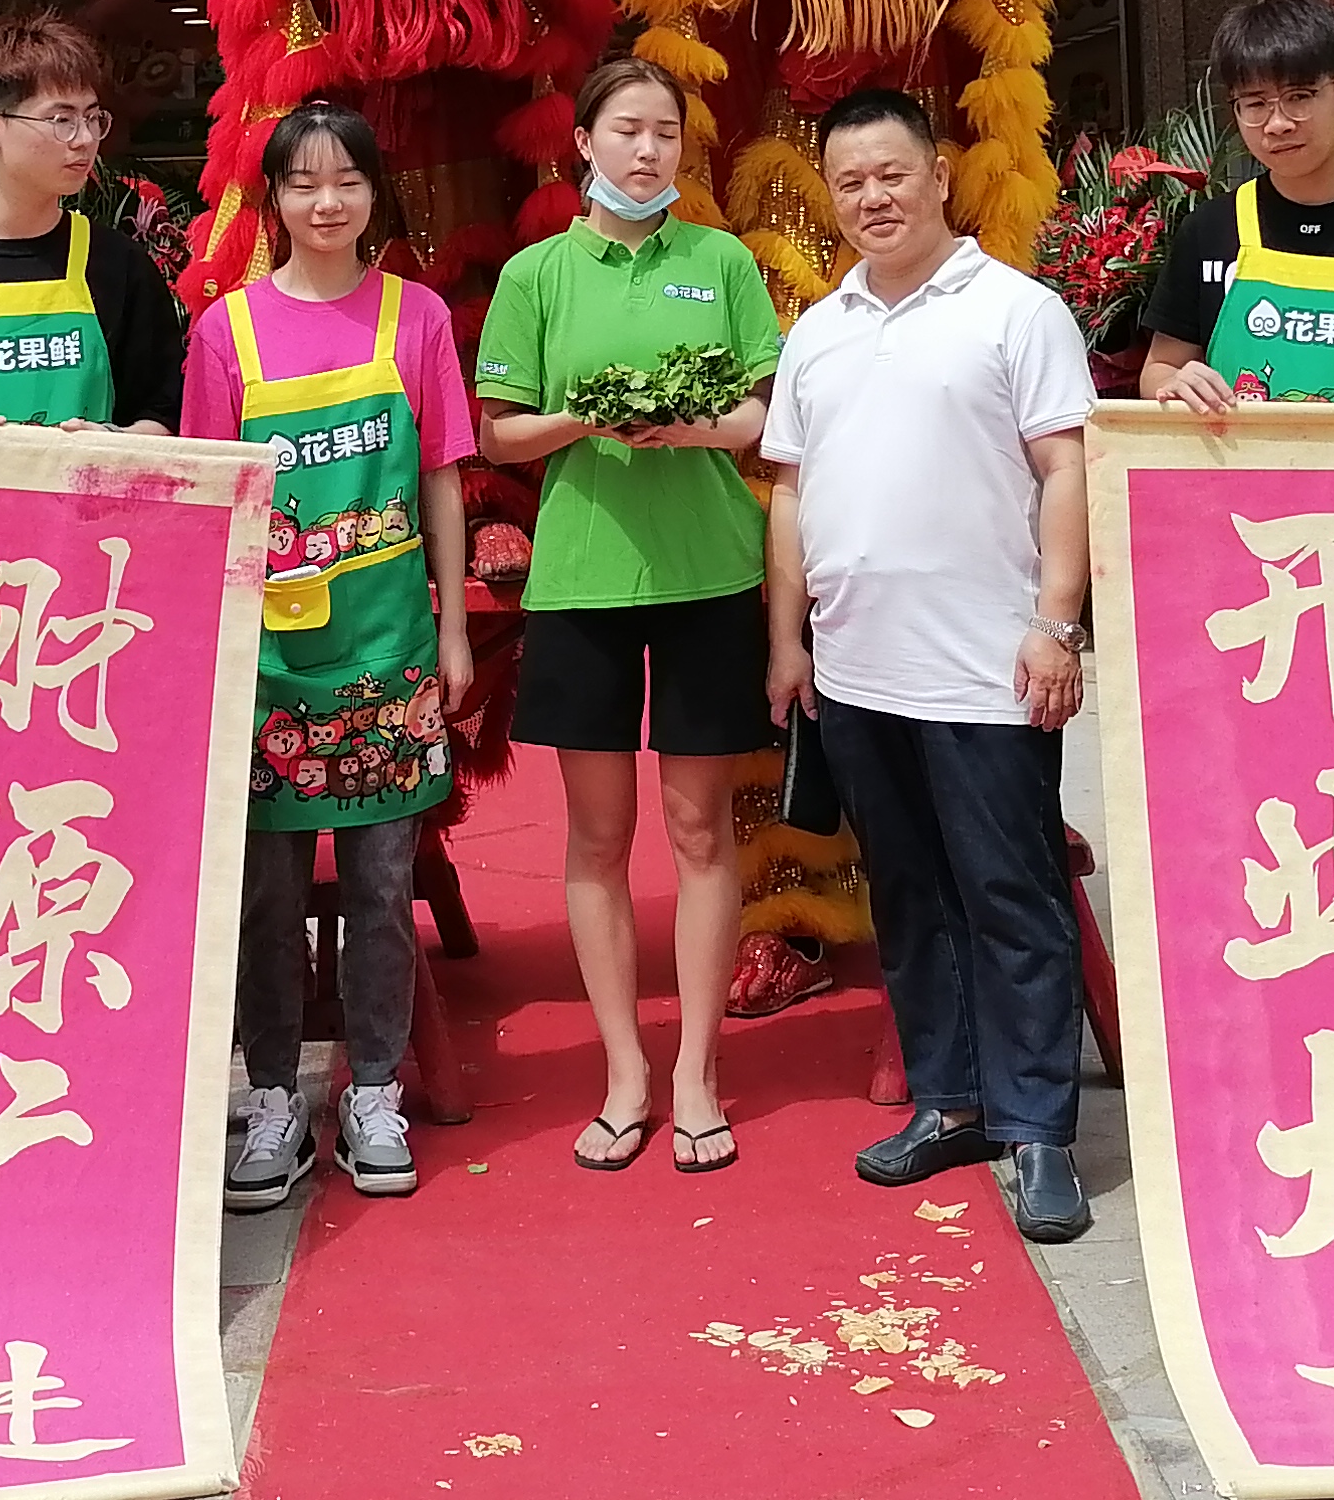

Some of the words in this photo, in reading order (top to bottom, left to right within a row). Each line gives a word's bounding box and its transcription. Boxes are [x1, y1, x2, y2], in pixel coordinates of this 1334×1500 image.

[1299, 224, 1322, 234] OFF
[298, 413, 390, 466] 花果鲜
